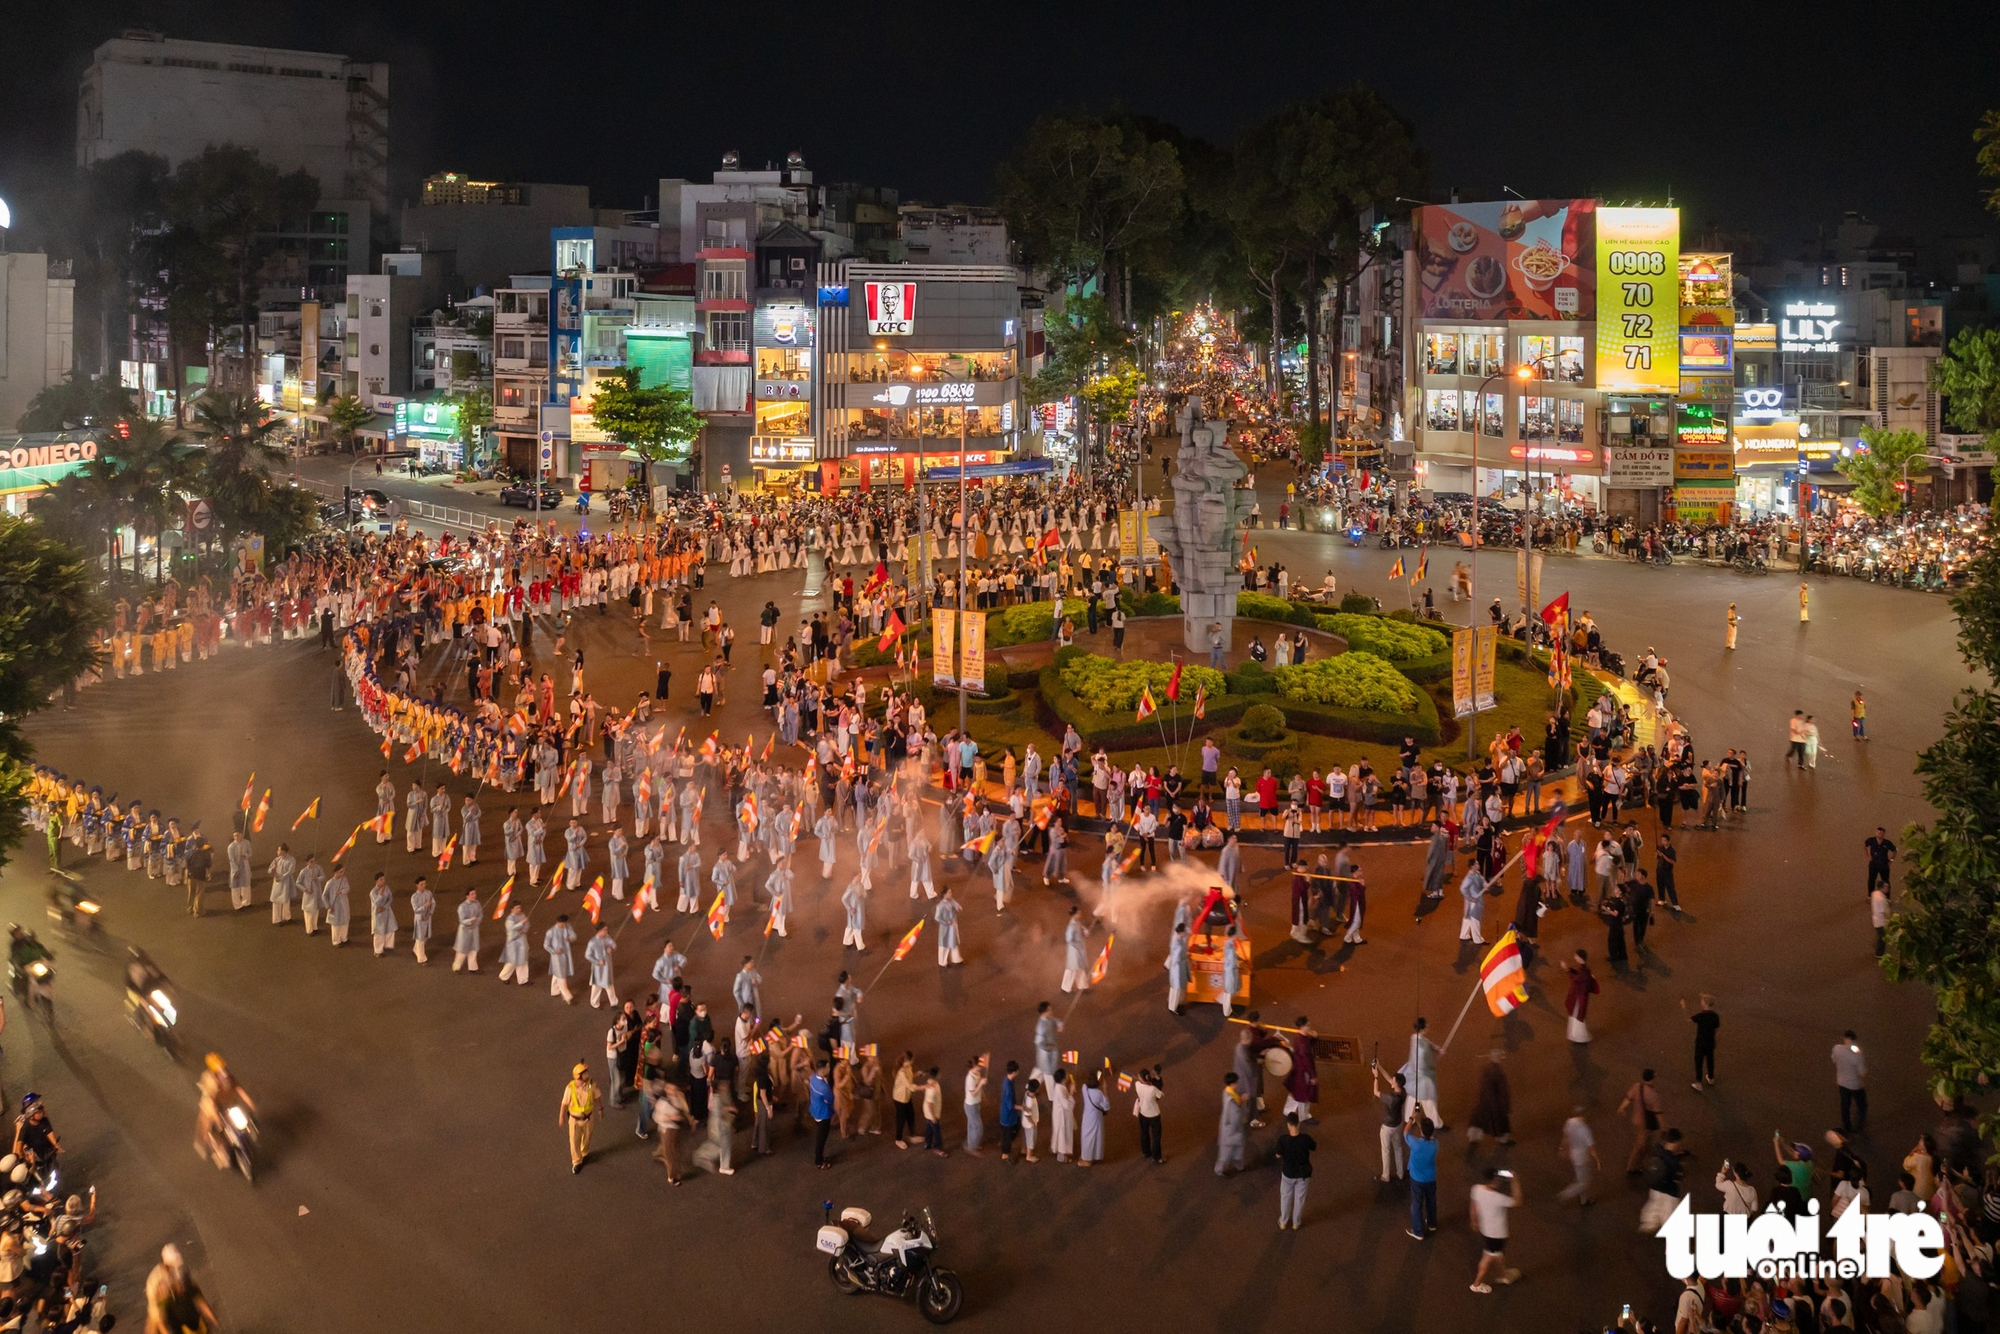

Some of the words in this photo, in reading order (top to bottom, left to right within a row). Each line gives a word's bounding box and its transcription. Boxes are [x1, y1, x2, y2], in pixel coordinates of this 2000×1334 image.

[1609, 251, 1666, 276] 0908
[1435, 298, 1491, 310] LOTTERIA
[1622, 282, 1653, 307] 70
[876, 321, 907, 333] KFC
[1621, 313, 1653, 338] 72
[1781, 318, 1841, 341] LILY
[1623, 345, 1652, 370] 71
[915, 388, 939, 399] 1900
[940, 383, 975, 398] 6886
[0, 440, 98, 470] COMECO
[753, 446, 777, 456] RYO
[779, 447, 811, 457] SUSHI
[966, 454, 986, 462] KFC
[1657, 452, 1670, 460] T2
